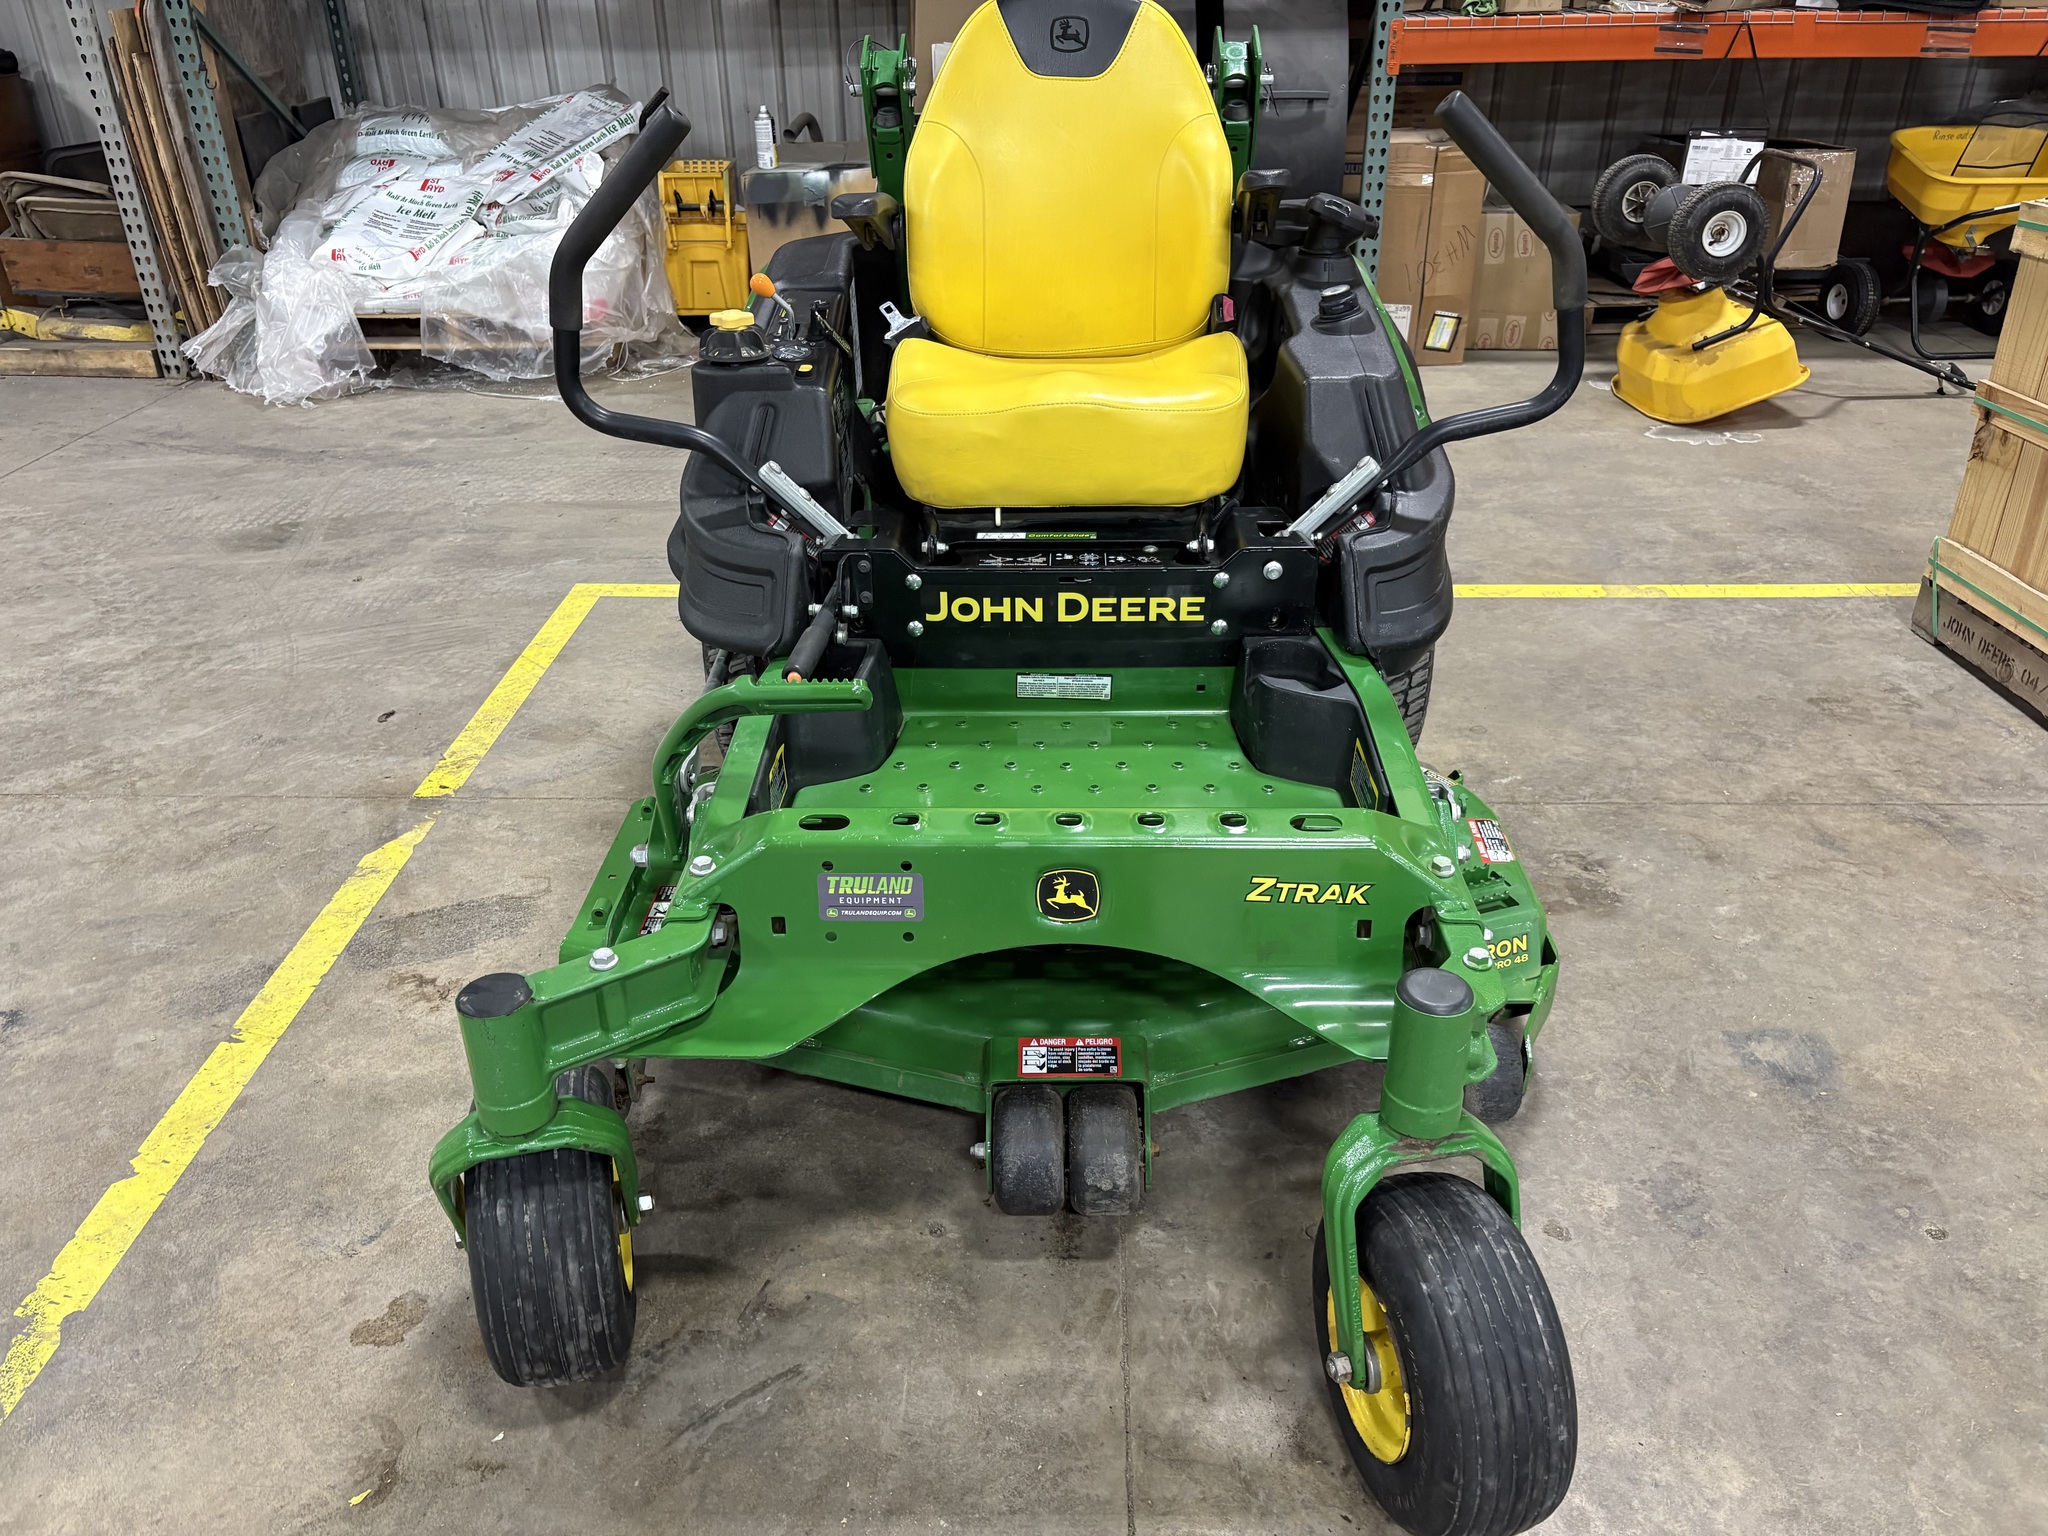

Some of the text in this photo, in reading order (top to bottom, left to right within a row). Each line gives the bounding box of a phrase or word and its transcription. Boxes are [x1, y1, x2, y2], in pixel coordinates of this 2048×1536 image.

[401, 129, 418, 137] Green
[592, 131, 608, 143] Earth
[606, 122, 619, 136] Ice
[616, 113, 636, 129] Melt
[1933, 130, 1955, 141] Rinse
[386, 190, 400, 201] Half
[424, 200, 442, 209] Green
[466, 190, 484, 205] Melt
[396, 206, 436, 220] Ice Melt
[926, 591, 1206, 623] JOHN DEERE
[1943, 616, 1975, 646] JOHN
[826, 876, 914, 895] TRULAND
[1244, 876, 1373, 905] ZTRAK
[839, 897, 902, 905] EQUIPMENT
[1514, 954, 1529, 964] 48
